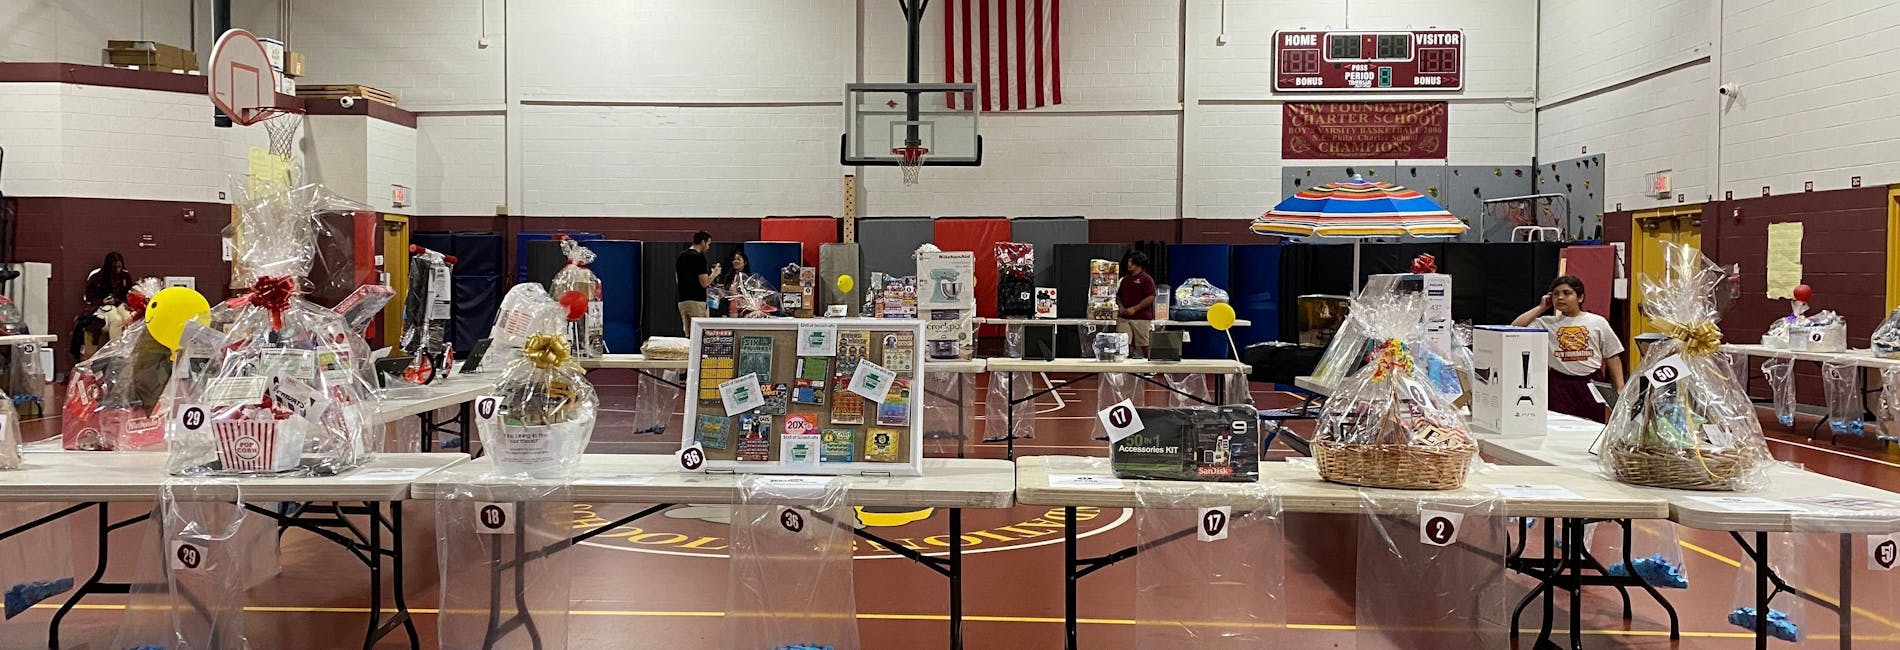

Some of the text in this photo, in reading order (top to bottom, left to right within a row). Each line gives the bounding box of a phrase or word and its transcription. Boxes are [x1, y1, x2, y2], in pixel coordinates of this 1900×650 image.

[1285, 34, 1317, 46] HOME
[1415, 33, 1459, 45] VISITOR
[1296, 77, 1323, 86] BONUS
[1345, 71, 1375, 80] PERIOD
[1414, 76, 1441, 85] BONUS
[1288, 103, 1444, 116] NEW FOUNDATIONS
[1291, 114, 1440, 126] CHARTER SCHOOL
[1318, 127, 1357, 135] VARSITY
[1360, 127, 1420, 135] BASKETBALL
[1318, 142, 1411, 153] CHAMPIONS
[1655, 366, 1674, 380] 50
[482, 401, 492, 415] 18
[187, 412, 200, 426] 29
[1112, 407, 1126, 425] 17
[787, 420, 805, 429] 20X
[1118, 444, 1179, 454] Accessories KIT
[684, 450, 700, 467] 36
[1199, 467, 1228, 475] SanDisk
[486, 509, 500, 521] 18
[785, 511, 799, 529] 36
[1207, 513, 1222, 531] 17
[1435, 520, 1445, 539] 2
[183, 547, 196, 565] 29
